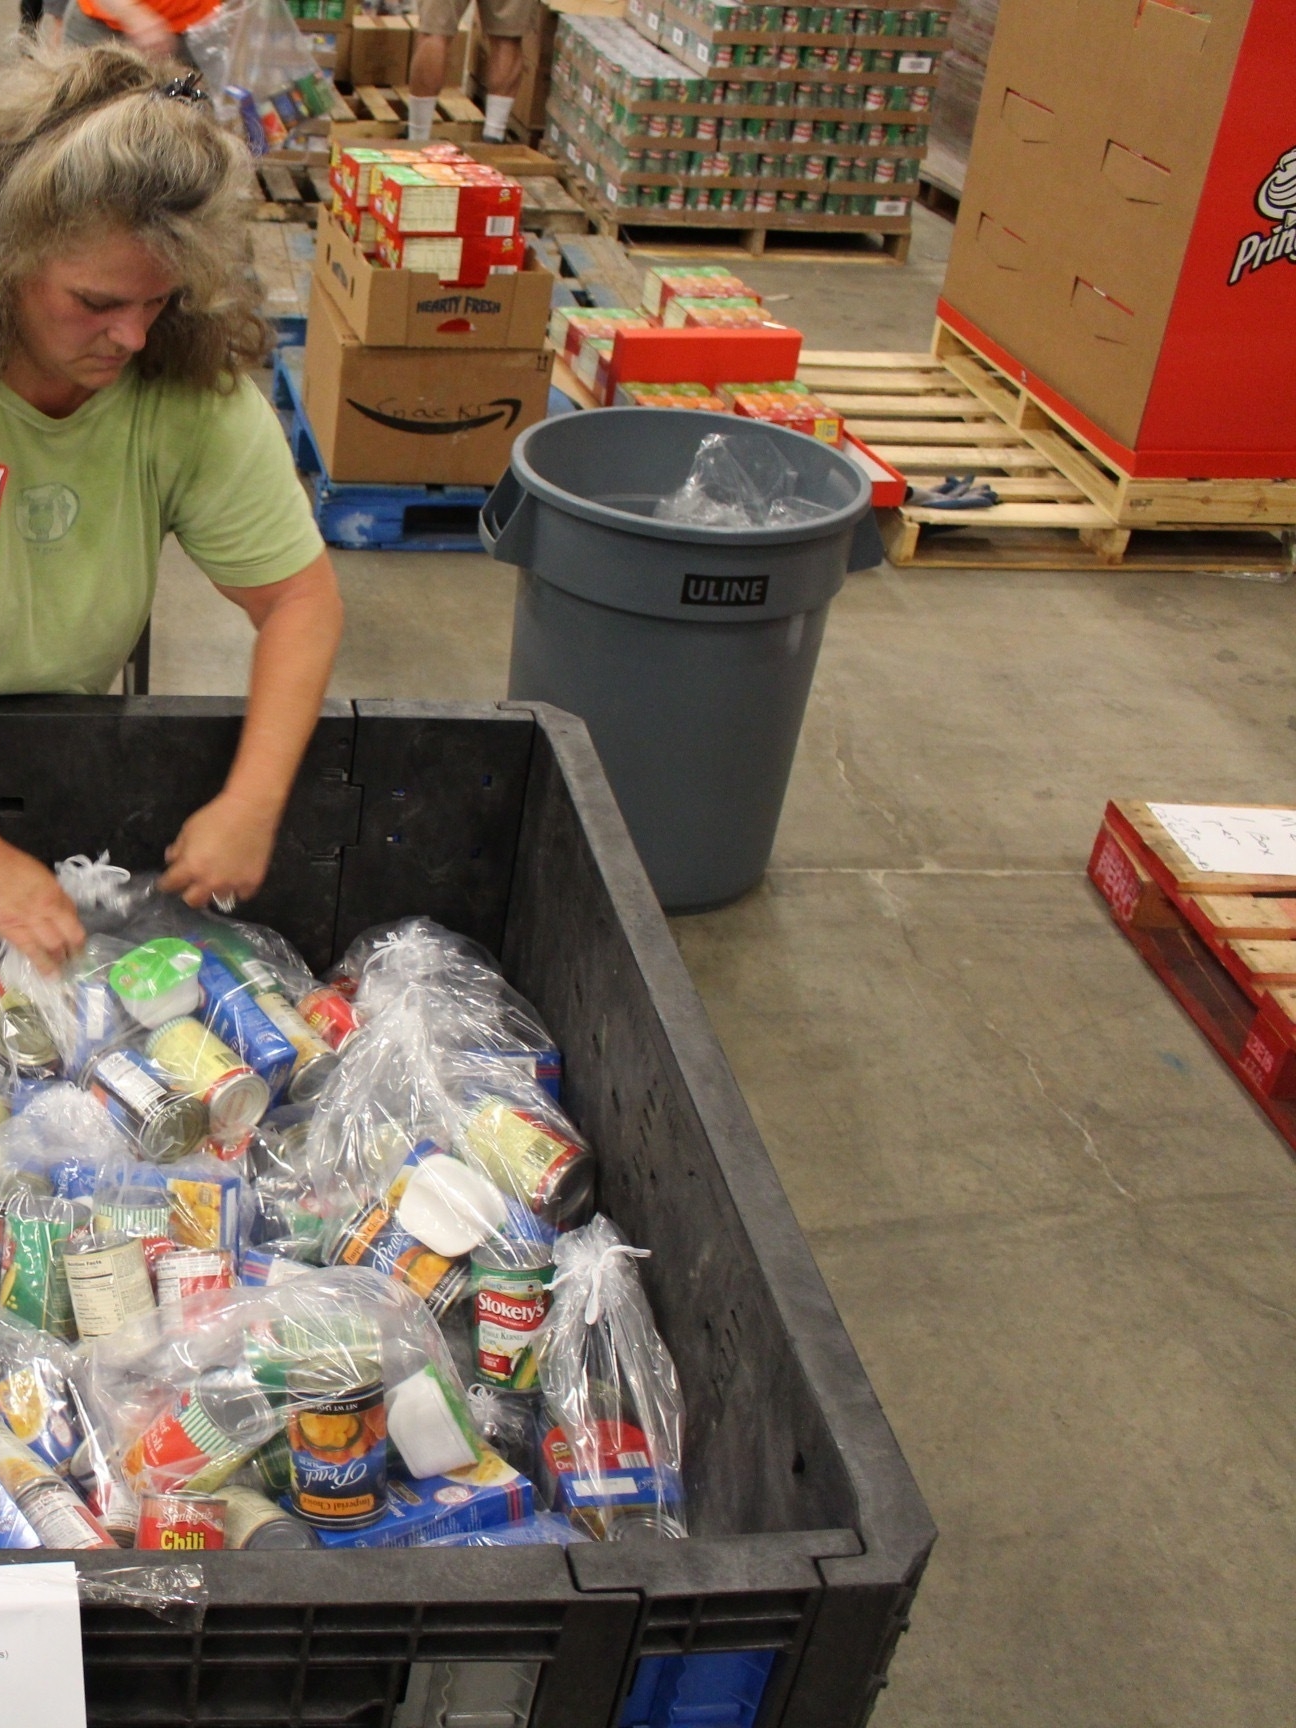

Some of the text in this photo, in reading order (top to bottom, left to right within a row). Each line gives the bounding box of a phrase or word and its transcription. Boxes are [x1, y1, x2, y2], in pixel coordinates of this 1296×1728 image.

[416, 296, 501, 314] HEARTY FRESH
[688, 580, 764, 602] ULINE
[478, 1292, 544, 1323] Stokely's
[304, 1462, 368, 1490] Peach
[332, 1498, 371, 1511] Imperial
[160, 1530, 206, 1550] Chili
